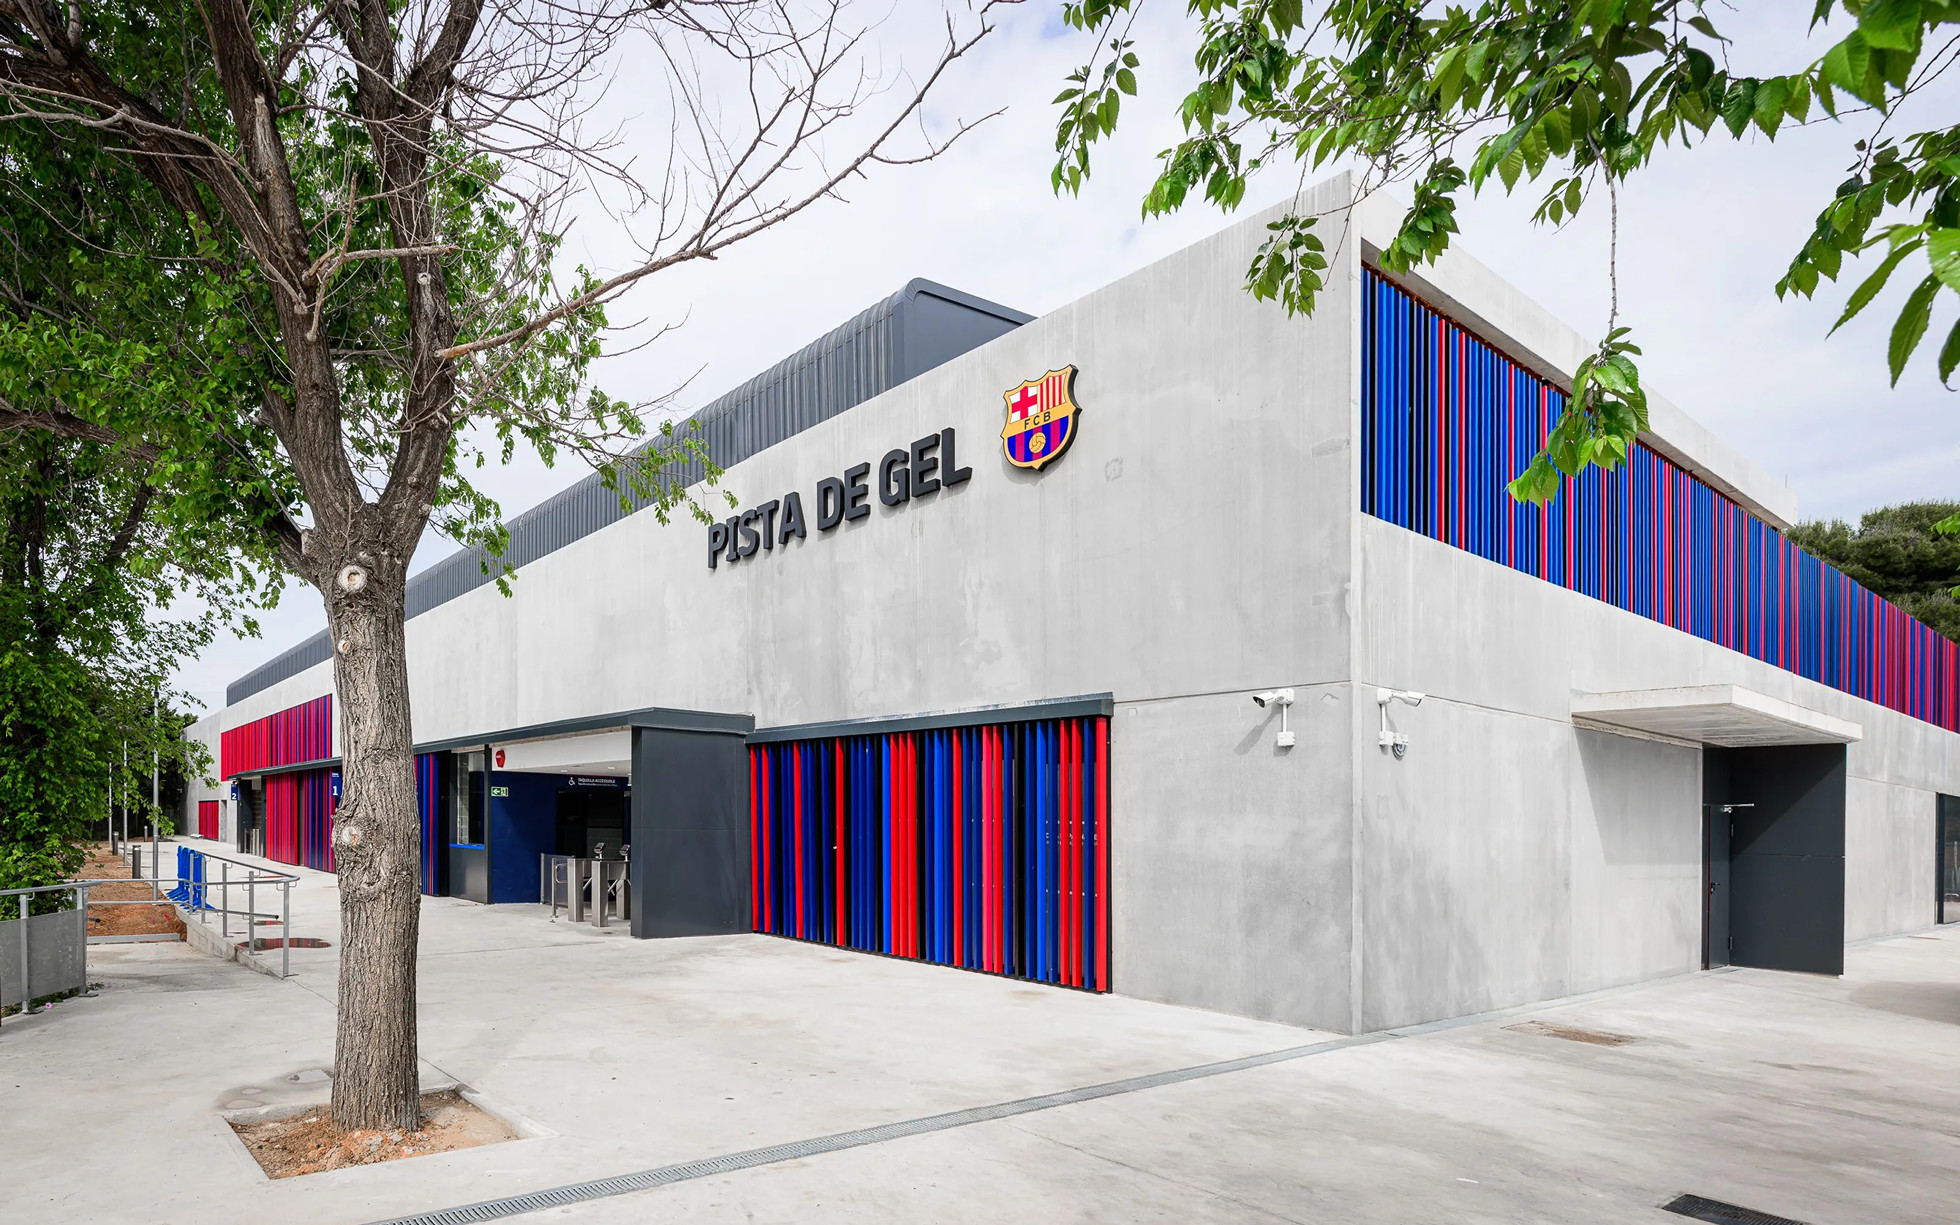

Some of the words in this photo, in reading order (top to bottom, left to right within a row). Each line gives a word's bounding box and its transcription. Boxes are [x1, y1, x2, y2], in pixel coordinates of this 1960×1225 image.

[708, 491, 806, 569] PISTA
[817, 462, 870, 531] DE
[879, 427, 973, 506] GEL
[332, 785, 339, 796] 1
